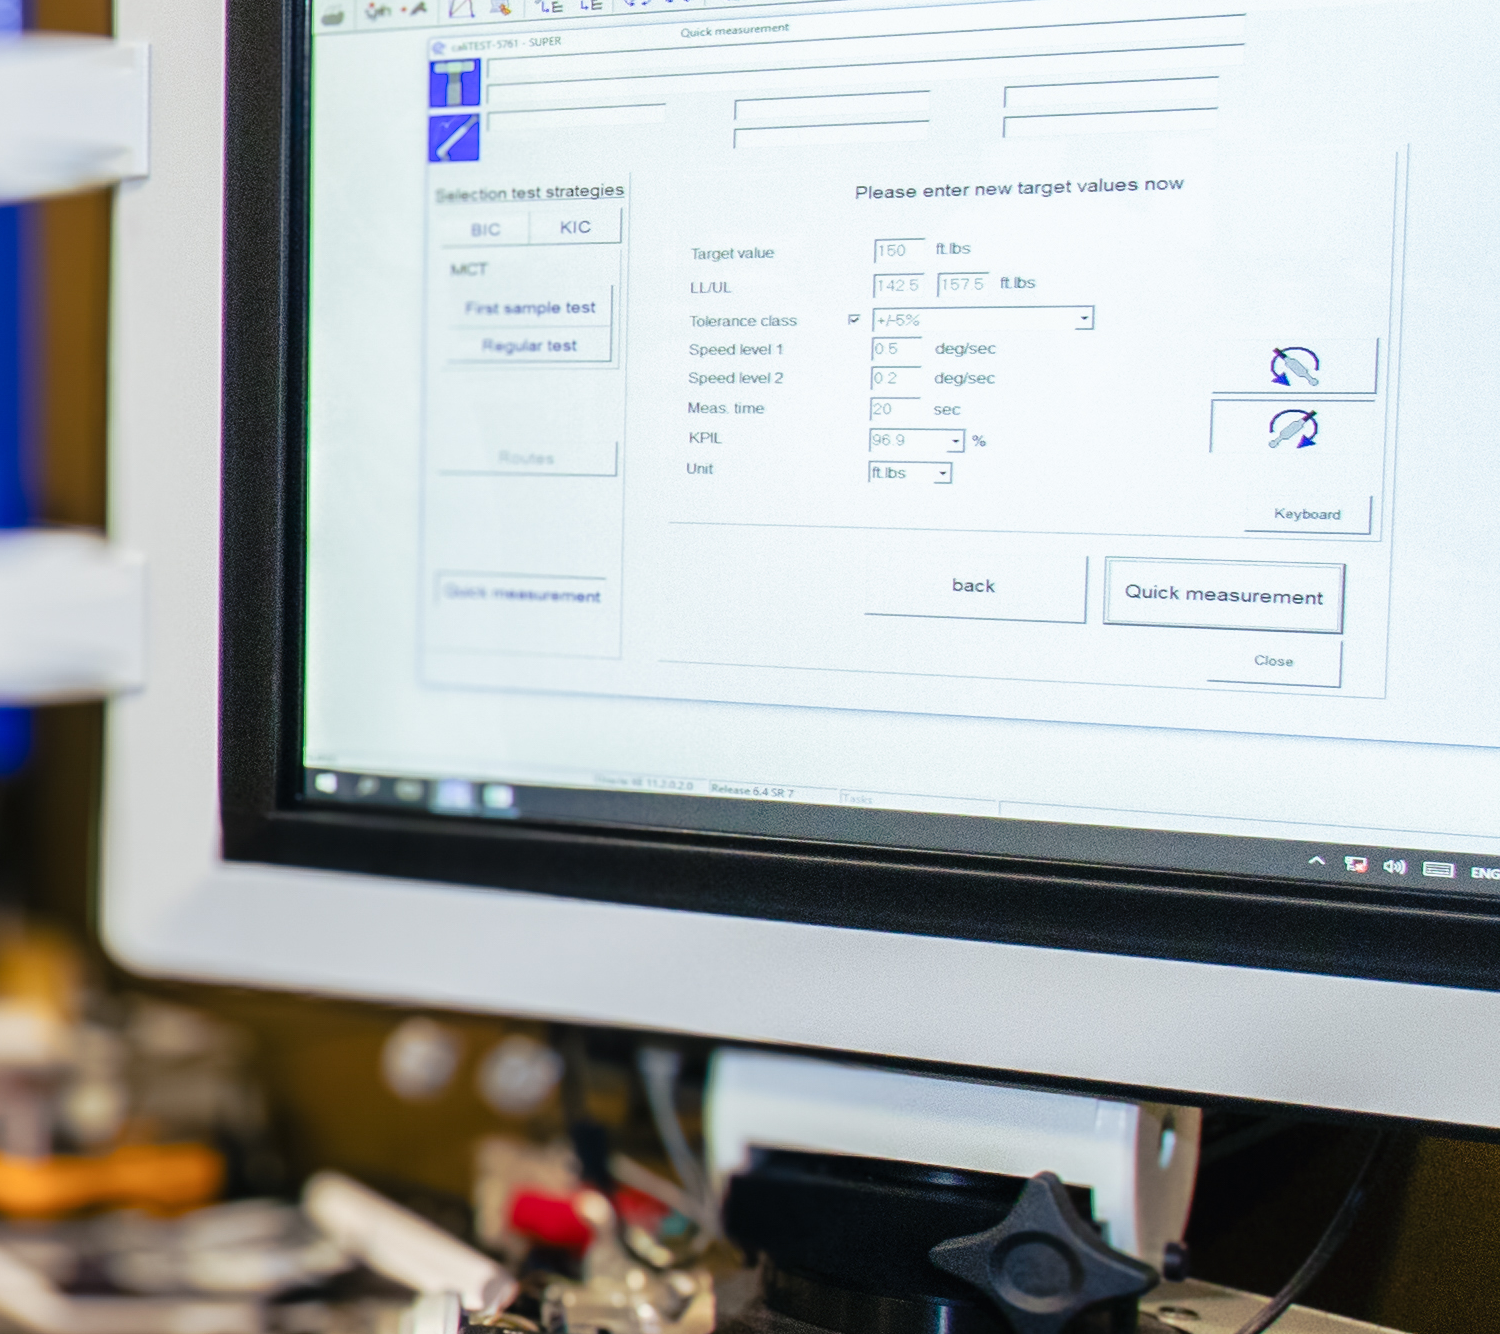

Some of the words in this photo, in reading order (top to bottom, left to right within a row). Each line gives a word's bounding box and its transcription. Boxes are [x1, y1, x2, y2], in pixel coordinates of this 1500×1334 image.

[680, 26, 712, 39] Quick
[714, 22, 790, 37] measurement
[529, 36, 562, 47] SUPER
[435, 187, 508, 204] Selection
[511, 186, 541, 200] test
[546, 183, 625, 200] strategies
[855, 185, 917, 200] Please
[923, 184, 970, 198] enter
[975, 183, 1013, 196] new
[1018, 179, 1072, 197] target
[1077, 178, 1138, 193] values
[1144, 177, 1185, 191] now
[560, 220, 592, 235] KIC
[691, 247, 735, 263] Target
[737, 246, 776, 259] value
[879, 244, 906, 257] 150
[690, 281, 733, 294] LL/UL
[877, 278, 919, 292] 142.5
[943, 277, 984, 291] 157.5
[464, 301, 500, 316] First
[503, 301, 562, 318] sample
[565, 301, 597, 315] test
[689, 315, 757, 327] Tolerance
[760, 314, 798, 327] class
[481, 338, 543, 355] Regular
[547, 338, 578, 353] test
[688, 343, 736, 358] Speed
[739, 343, 771, 355] level
[776, 343, 783, 355] 1
[934, 342, 996, 357] deg/sec
[688, 371, 736, 386] Speed
[739, 371, 771, 384] level
[774, 371, 783, 384] 2
[934, 371, 996, 387] deg/sec
[734, 401, 765, 414] time
[872, 402, 892, 415] 20
[933, 405, 961, 416] sec
[872, 433, 905, 447] 96.9
[686, 462, 714, 475] Unit
[1274, 507, 1341, 522] Keyboard
[952, 577, 996, 595] back
[492, 586, 602, 604] measurement
[1125, 583, 1180, 602] Quick
[1185, 585, 1324, 608] measurement
[1254, 654, 1293, 667] Close
[711, 783, 751, 796] Release
[770, 787, 785, 798] SR
